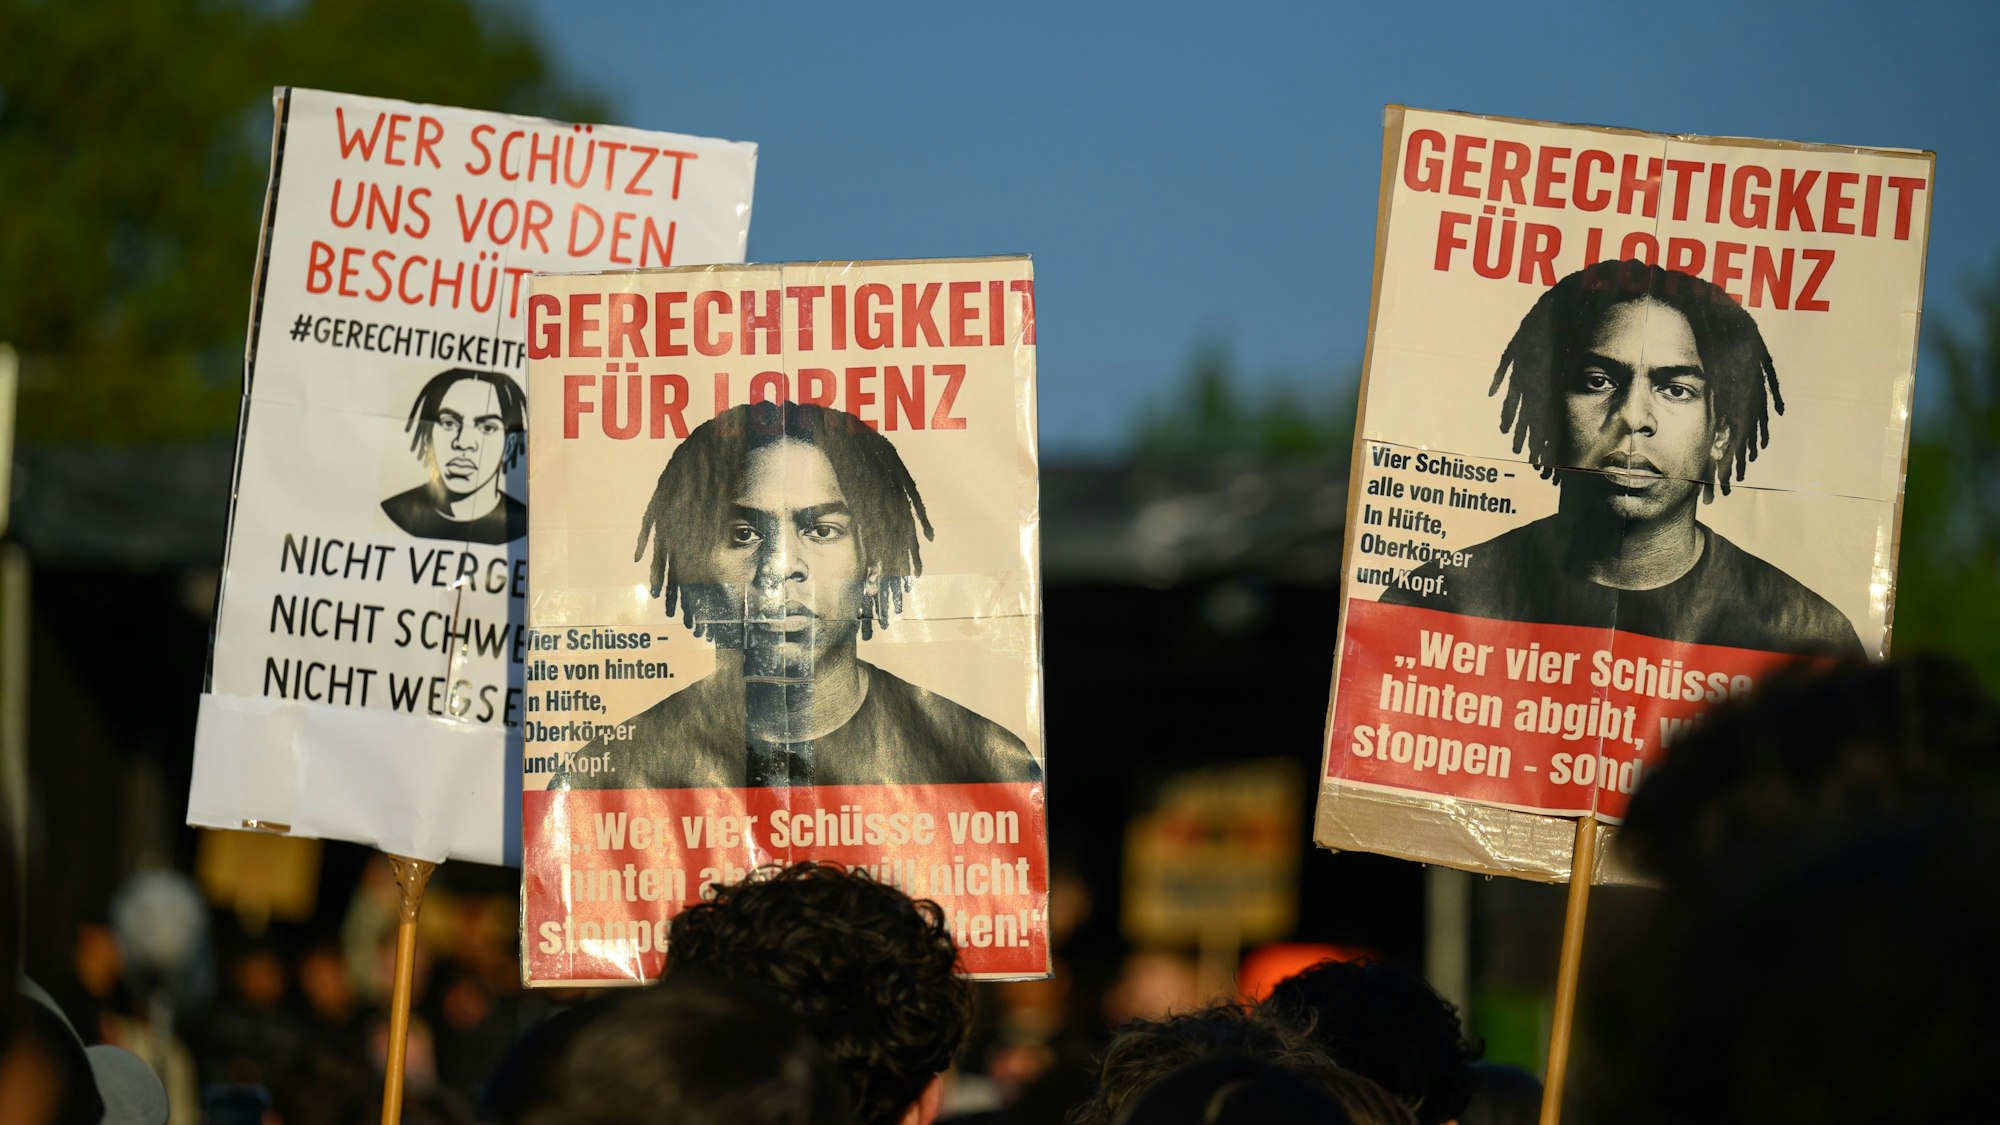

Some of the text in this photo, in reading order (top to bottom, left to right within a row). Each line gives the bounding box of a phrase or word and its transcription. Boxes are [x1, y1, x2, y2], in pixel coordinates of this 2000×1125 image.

[336, 106, 699, 200] WER SCHÜTZT
[1403, 128, 1926, 241] GERECHTIGKEIT
[330, 179, 676, 268] UNS VOR DEN
[1434, 205, 1563, 288] FÜR
[306, 241, 536, 319] BESCHÜT
[527, 280, 1036, 361] GERECHTIGKEIT
[563, 362, 690, 440] FÜR
[1367, 476, 1517, 514] alle von hinten.
[1372, 446, 1411, 470] Vier
[1415, 453, 1498, 483] Schüsse
[1360, 533, 1473, 569] Oberkörper
[1363, 504, 1447, 539] In Hüfte,
[281, 533, 527, 598] NICHT VERGE
[1357, 567, 1448, 597] und Kopf.
[269, 594, 525, 664] NICHT SCHWE
[566, 628, 651, 651] Schüsse
[263, 657, 522, 728] NICHT WEGSE
[564, 664, 599, 681] von
[605, 659, 675, 680] hinten.
[1394, 629, 1753, 704] „Wer vier Schüsse
[525, 720, 637, 746] Oberkörper
[546, 689, 607, 715] Hüfte,
[1379, 673, 1504, 730] hinten
[1514, 696, 1645, 751] abgibt,
[525, 752, 616, 778] und Kopf.
[1351, 723, 1511, 779] stoppen
[1550, 749, 1646, 796] sond
[682, 808, 758, 849] vier
[770, 805, 934, 850] Schüsse
[948, 809, 1020, 845] von
[561, 863, 687, 902] hinten
[930, 856, 1030, 896] nicht
